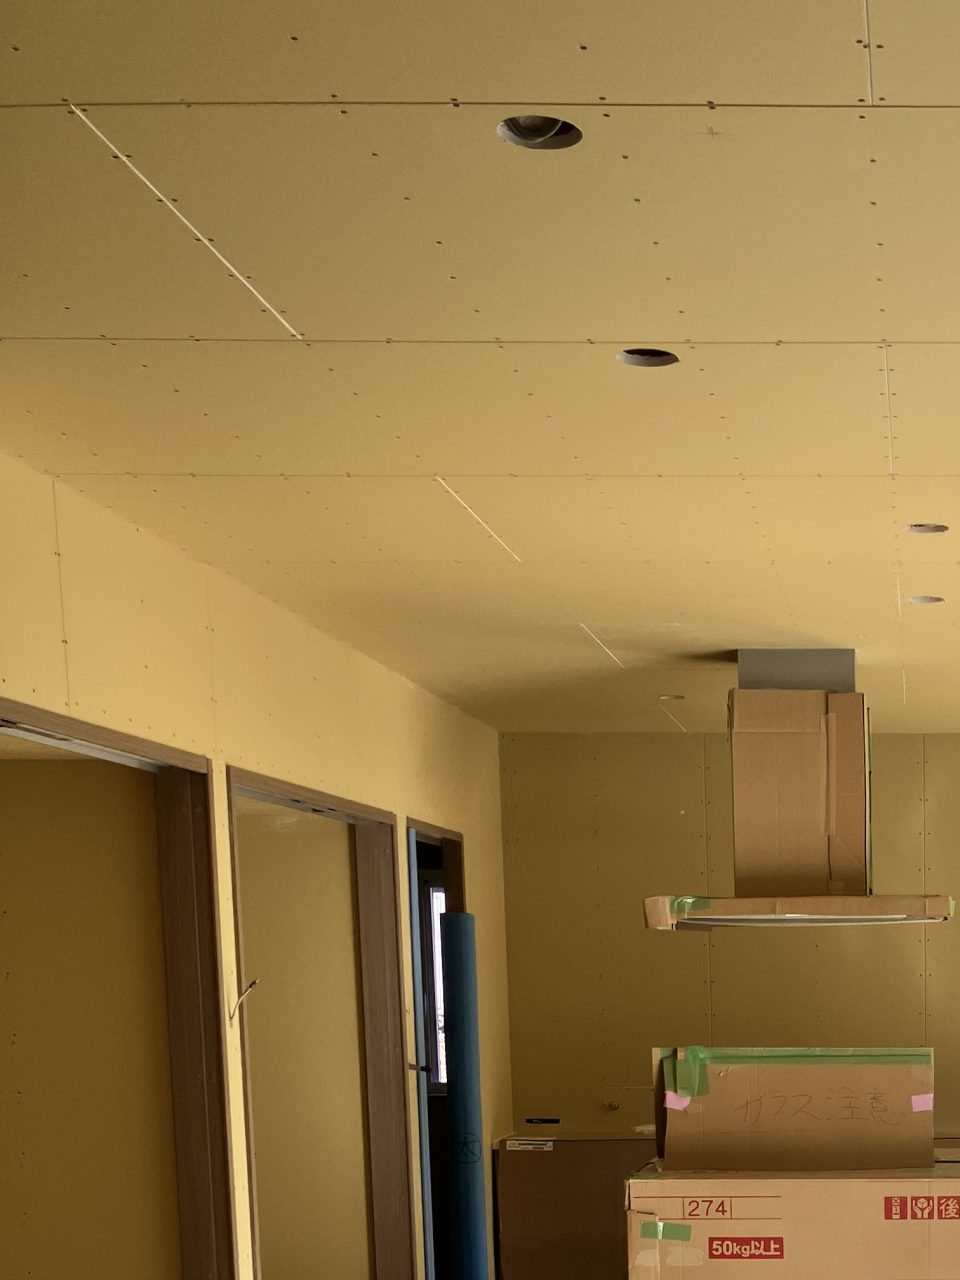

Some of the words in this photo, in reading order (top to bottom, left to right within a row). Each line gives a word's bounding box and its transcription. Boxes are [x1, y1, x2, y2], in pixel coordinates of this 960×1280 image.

[688, 1200, 728, 1217] 274
[939, 1197, 960, 1219] 後
[712, 1240, 781, 1258] 50kg以上
